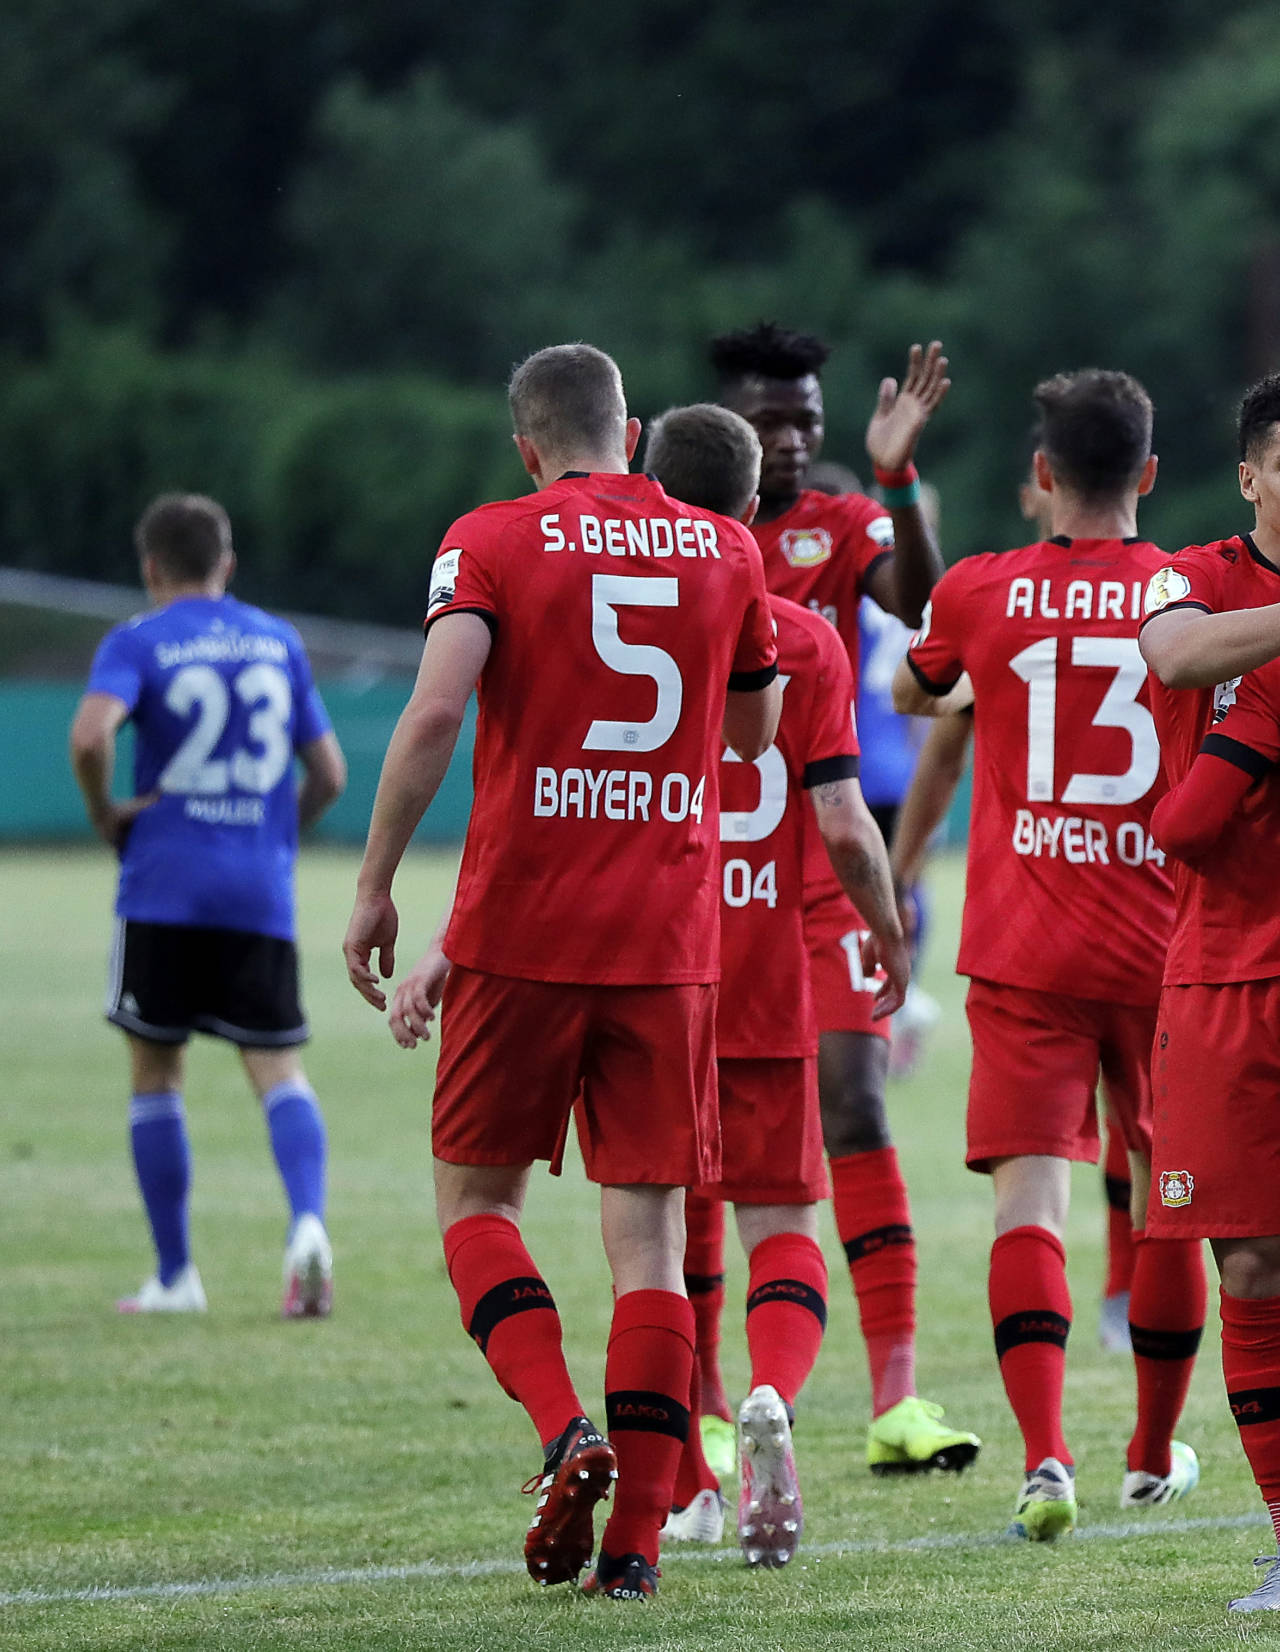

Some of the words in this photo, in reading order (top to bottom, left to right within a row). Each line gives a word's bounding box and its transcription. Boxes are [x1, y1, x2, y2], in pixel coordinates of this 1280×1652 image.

[539, 513, 721, 559] S.BENDER
[1006, 577, 1142, 620] ALARI
[581, 573, 683, 752] 5
[159, 662, 292, 795] 23
[1008, 636, 1161, 805] 13
[533, 766, 652, 822] BAYER
[660, 772, 706, 824] 04
[1012, 808, 1110, 865] BAYER
[1116, 822, 1166, 868] 04
[723, 858, 778, 909] 04
[512, 1285, 553, 1303] JAK
[615, 1402, 670, 1421] JAKO
[612, 1587, 645, 1600] COPA
